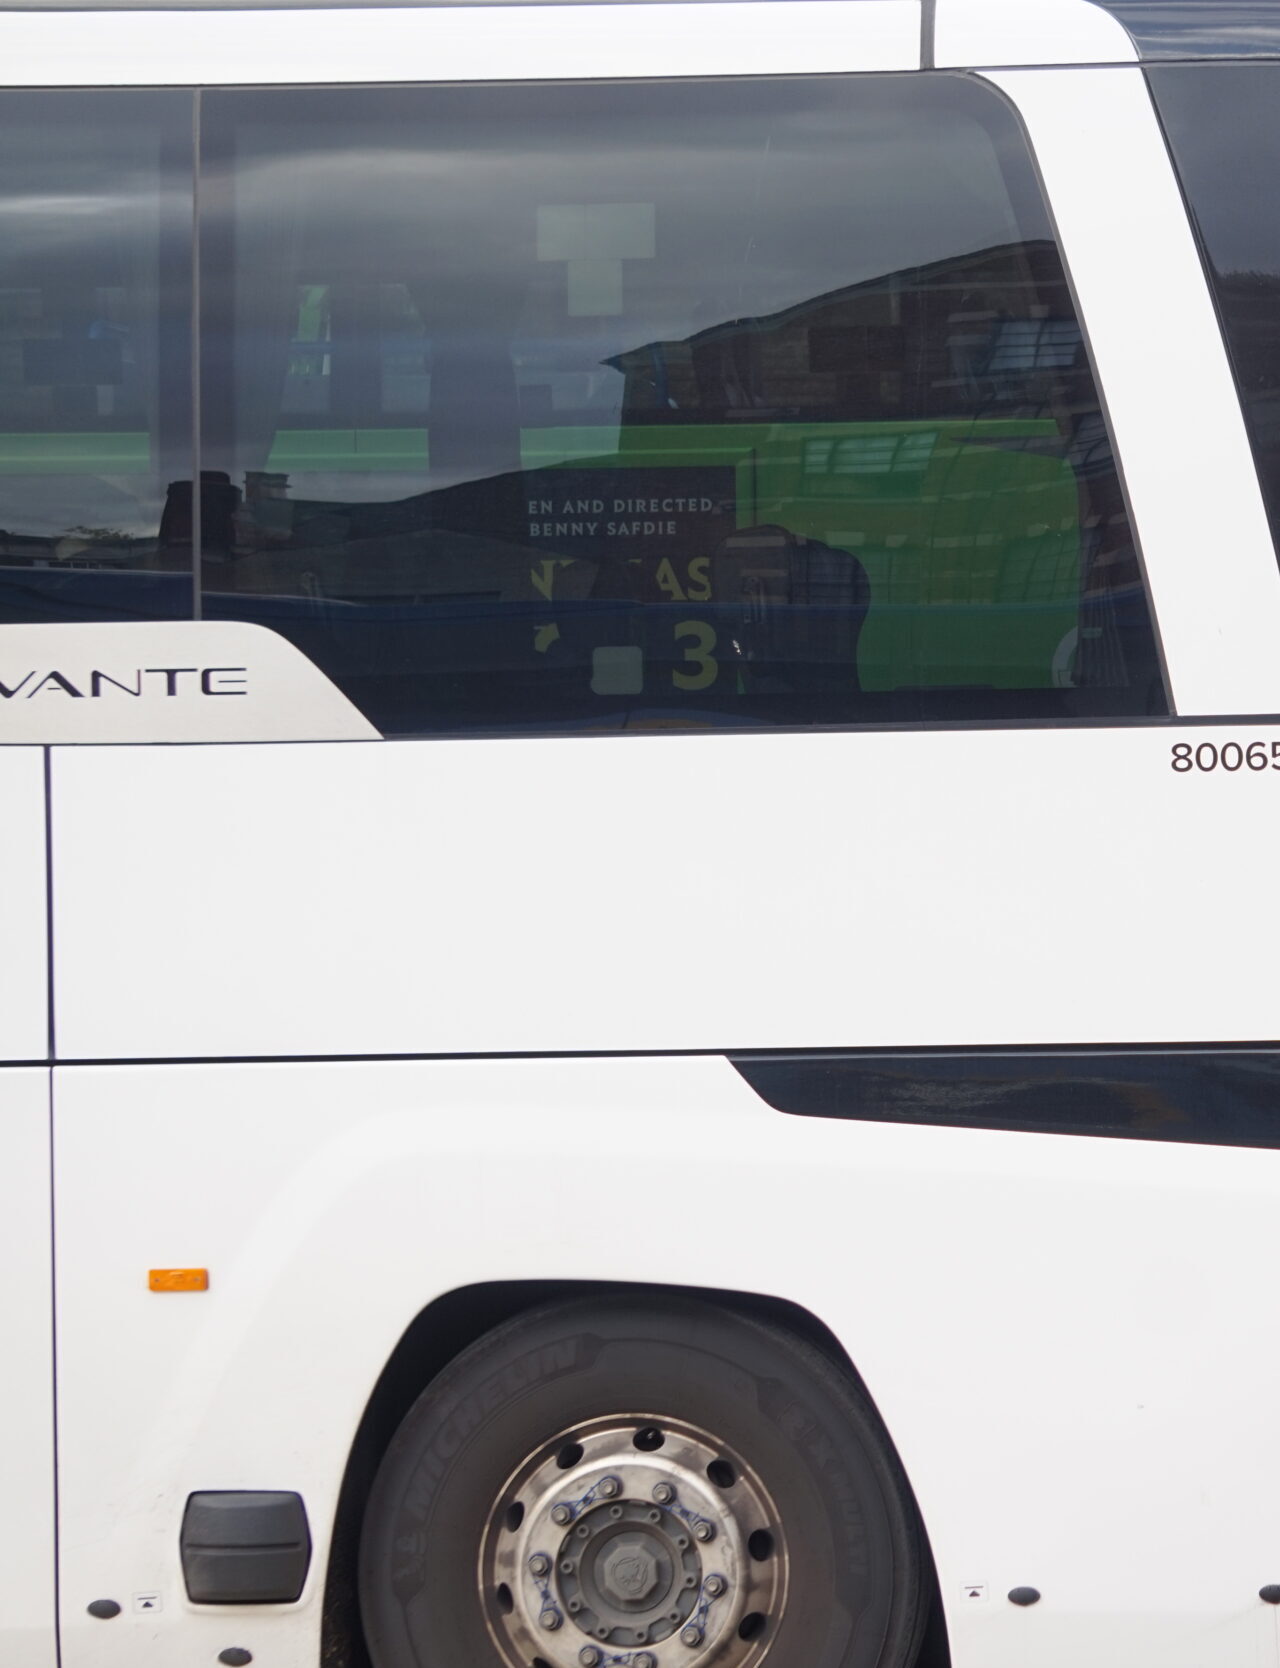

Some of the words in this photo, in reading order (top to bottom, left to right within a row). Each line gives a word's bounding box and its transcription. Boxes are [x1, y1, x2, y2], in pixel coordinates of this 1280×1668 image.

[528, 501, 553, 514] EN
[562, 500, 605, 514] AND
[613, 497, 713, 513] DIRECTED
[529, 522, 599, 537] BENNY
[606, 521, 677, 535] SAFDIE
[672, 619, 719, 691] 3
[402, 1338, 580, 1521] MICHELIN
